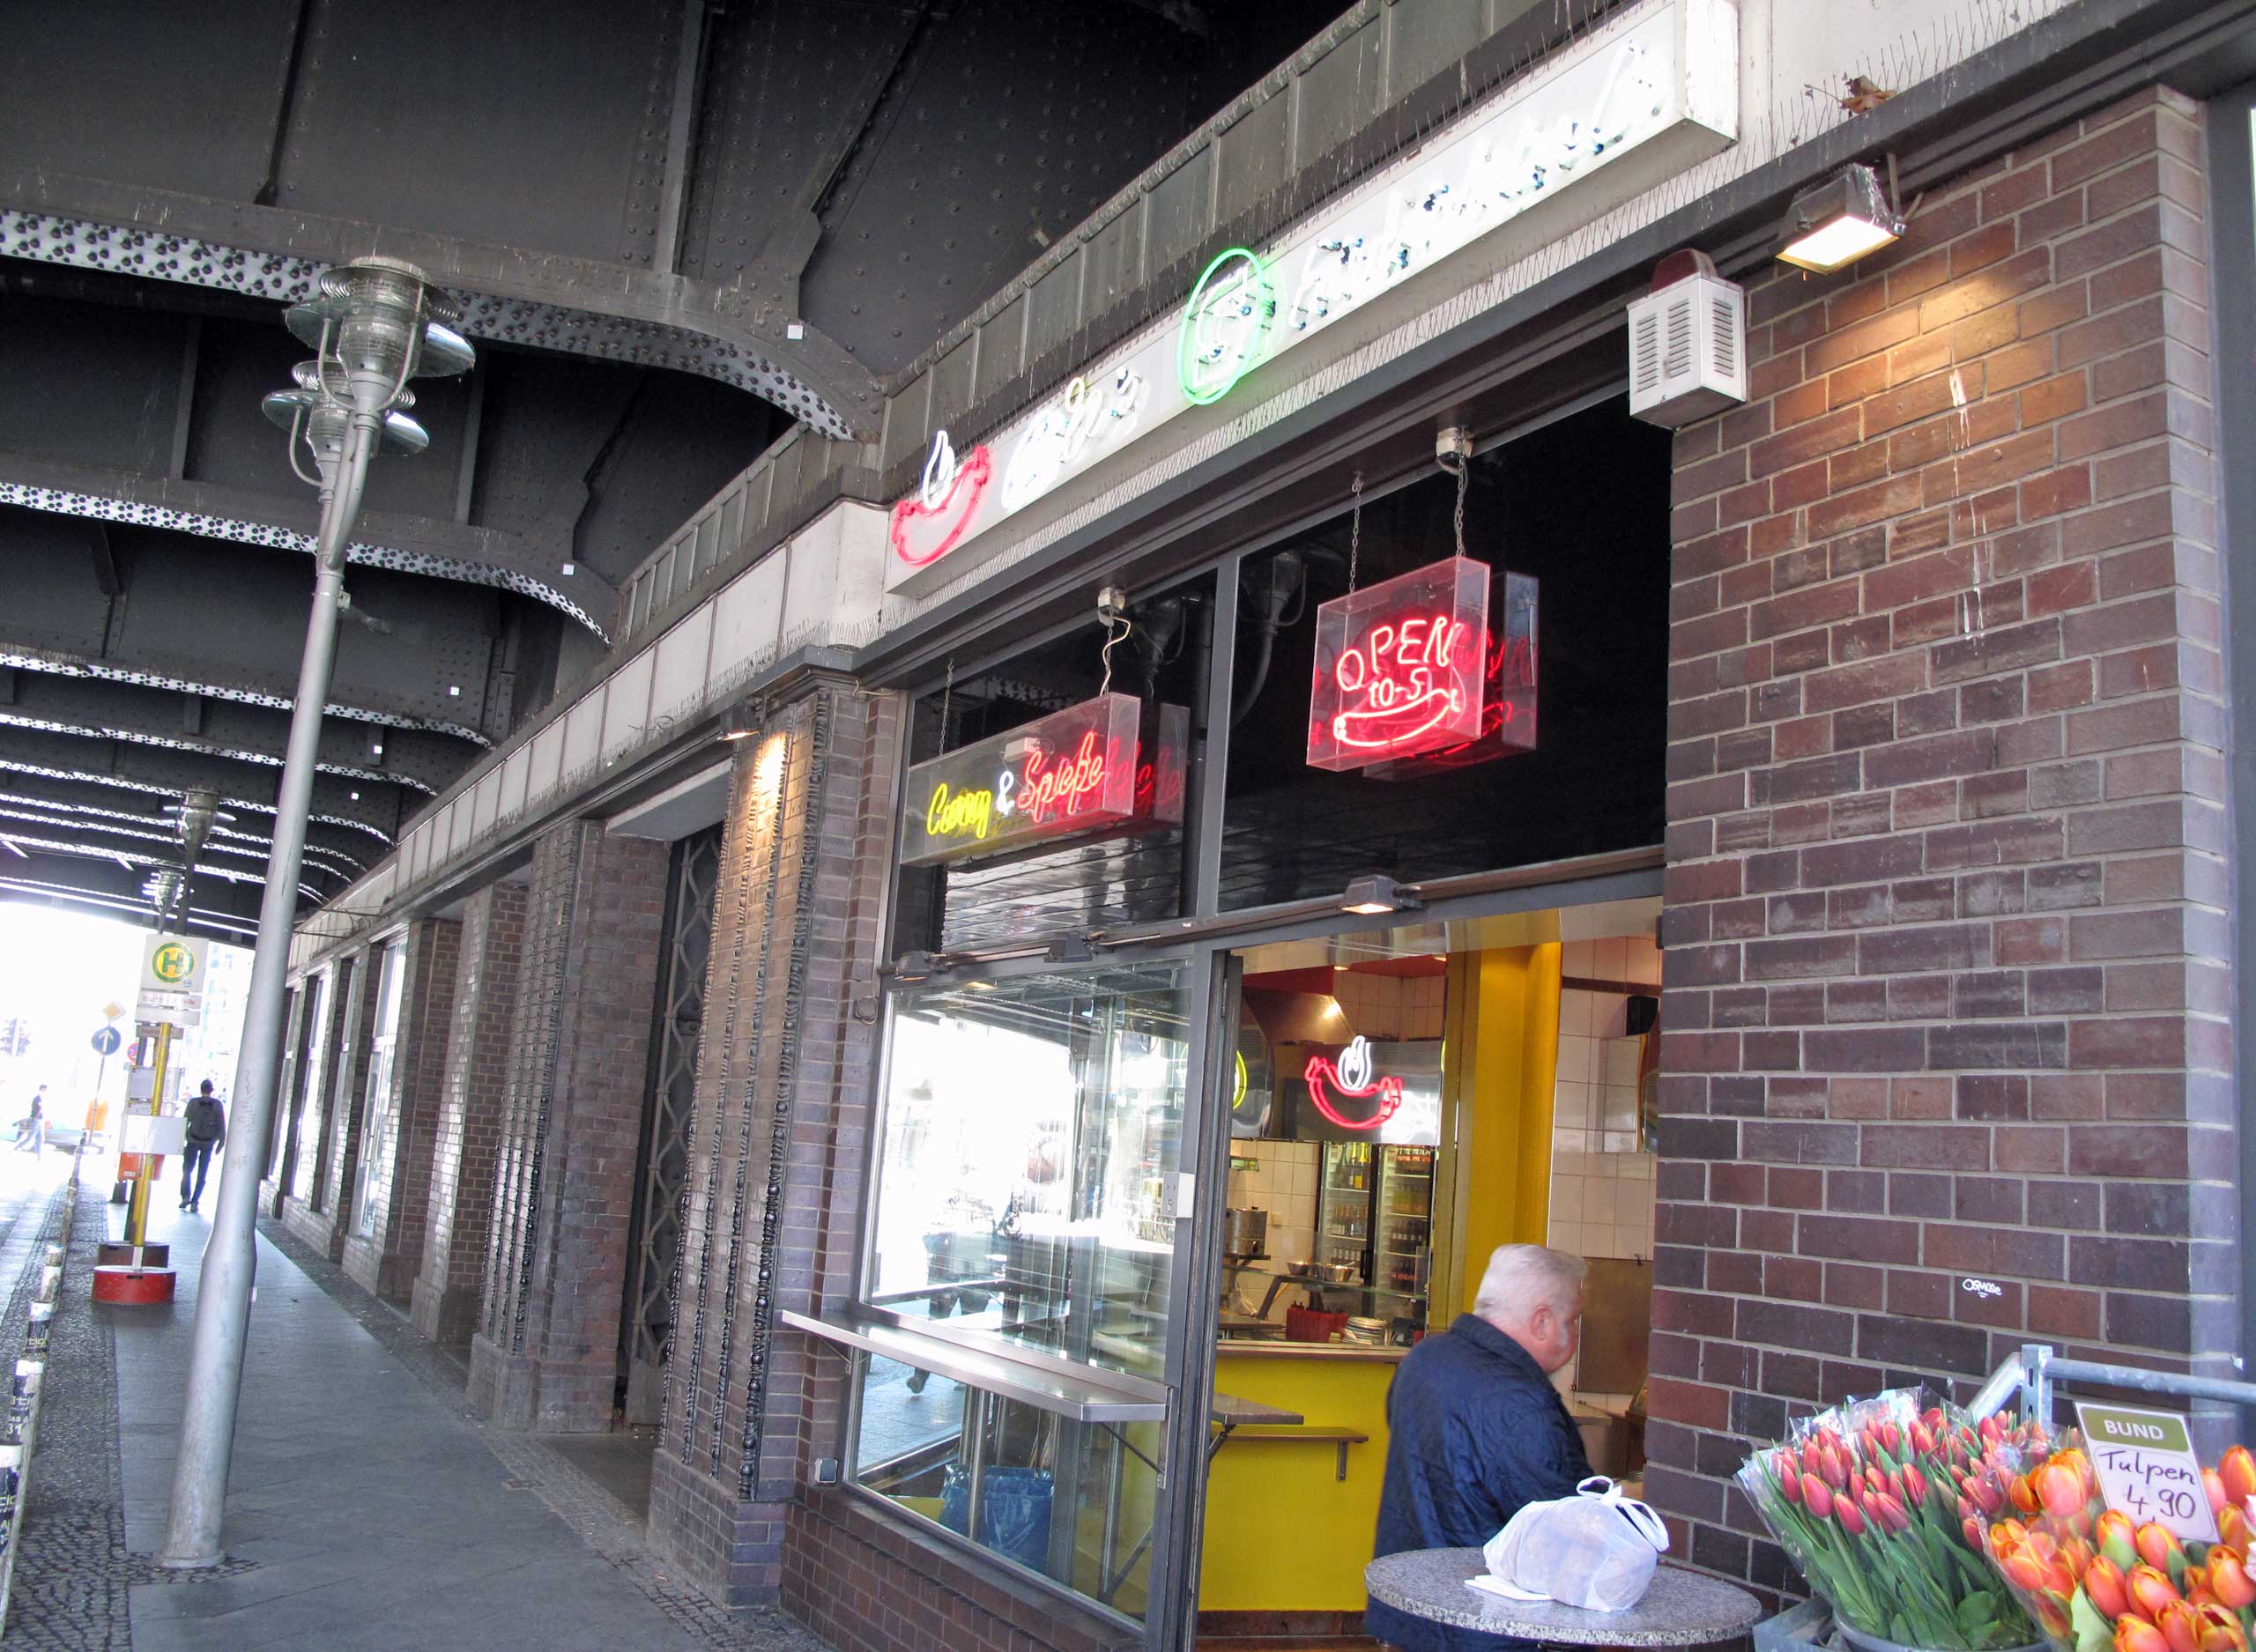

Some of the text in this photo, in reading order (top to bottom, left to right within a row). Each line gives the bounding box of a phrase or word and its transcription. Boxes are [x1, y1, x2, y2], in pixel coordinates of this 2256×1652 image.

[1336, 615, 1455, 691] OPEN
[1368, 666, 1429, 708] 10-5
[926, 730, 1106, 840] Curry & Spieße
[161, 951, 185, 974] H
[2104, 1419, 2165, 1441] BUND
[2098, 1450, 2196, 1485] Tulpen
